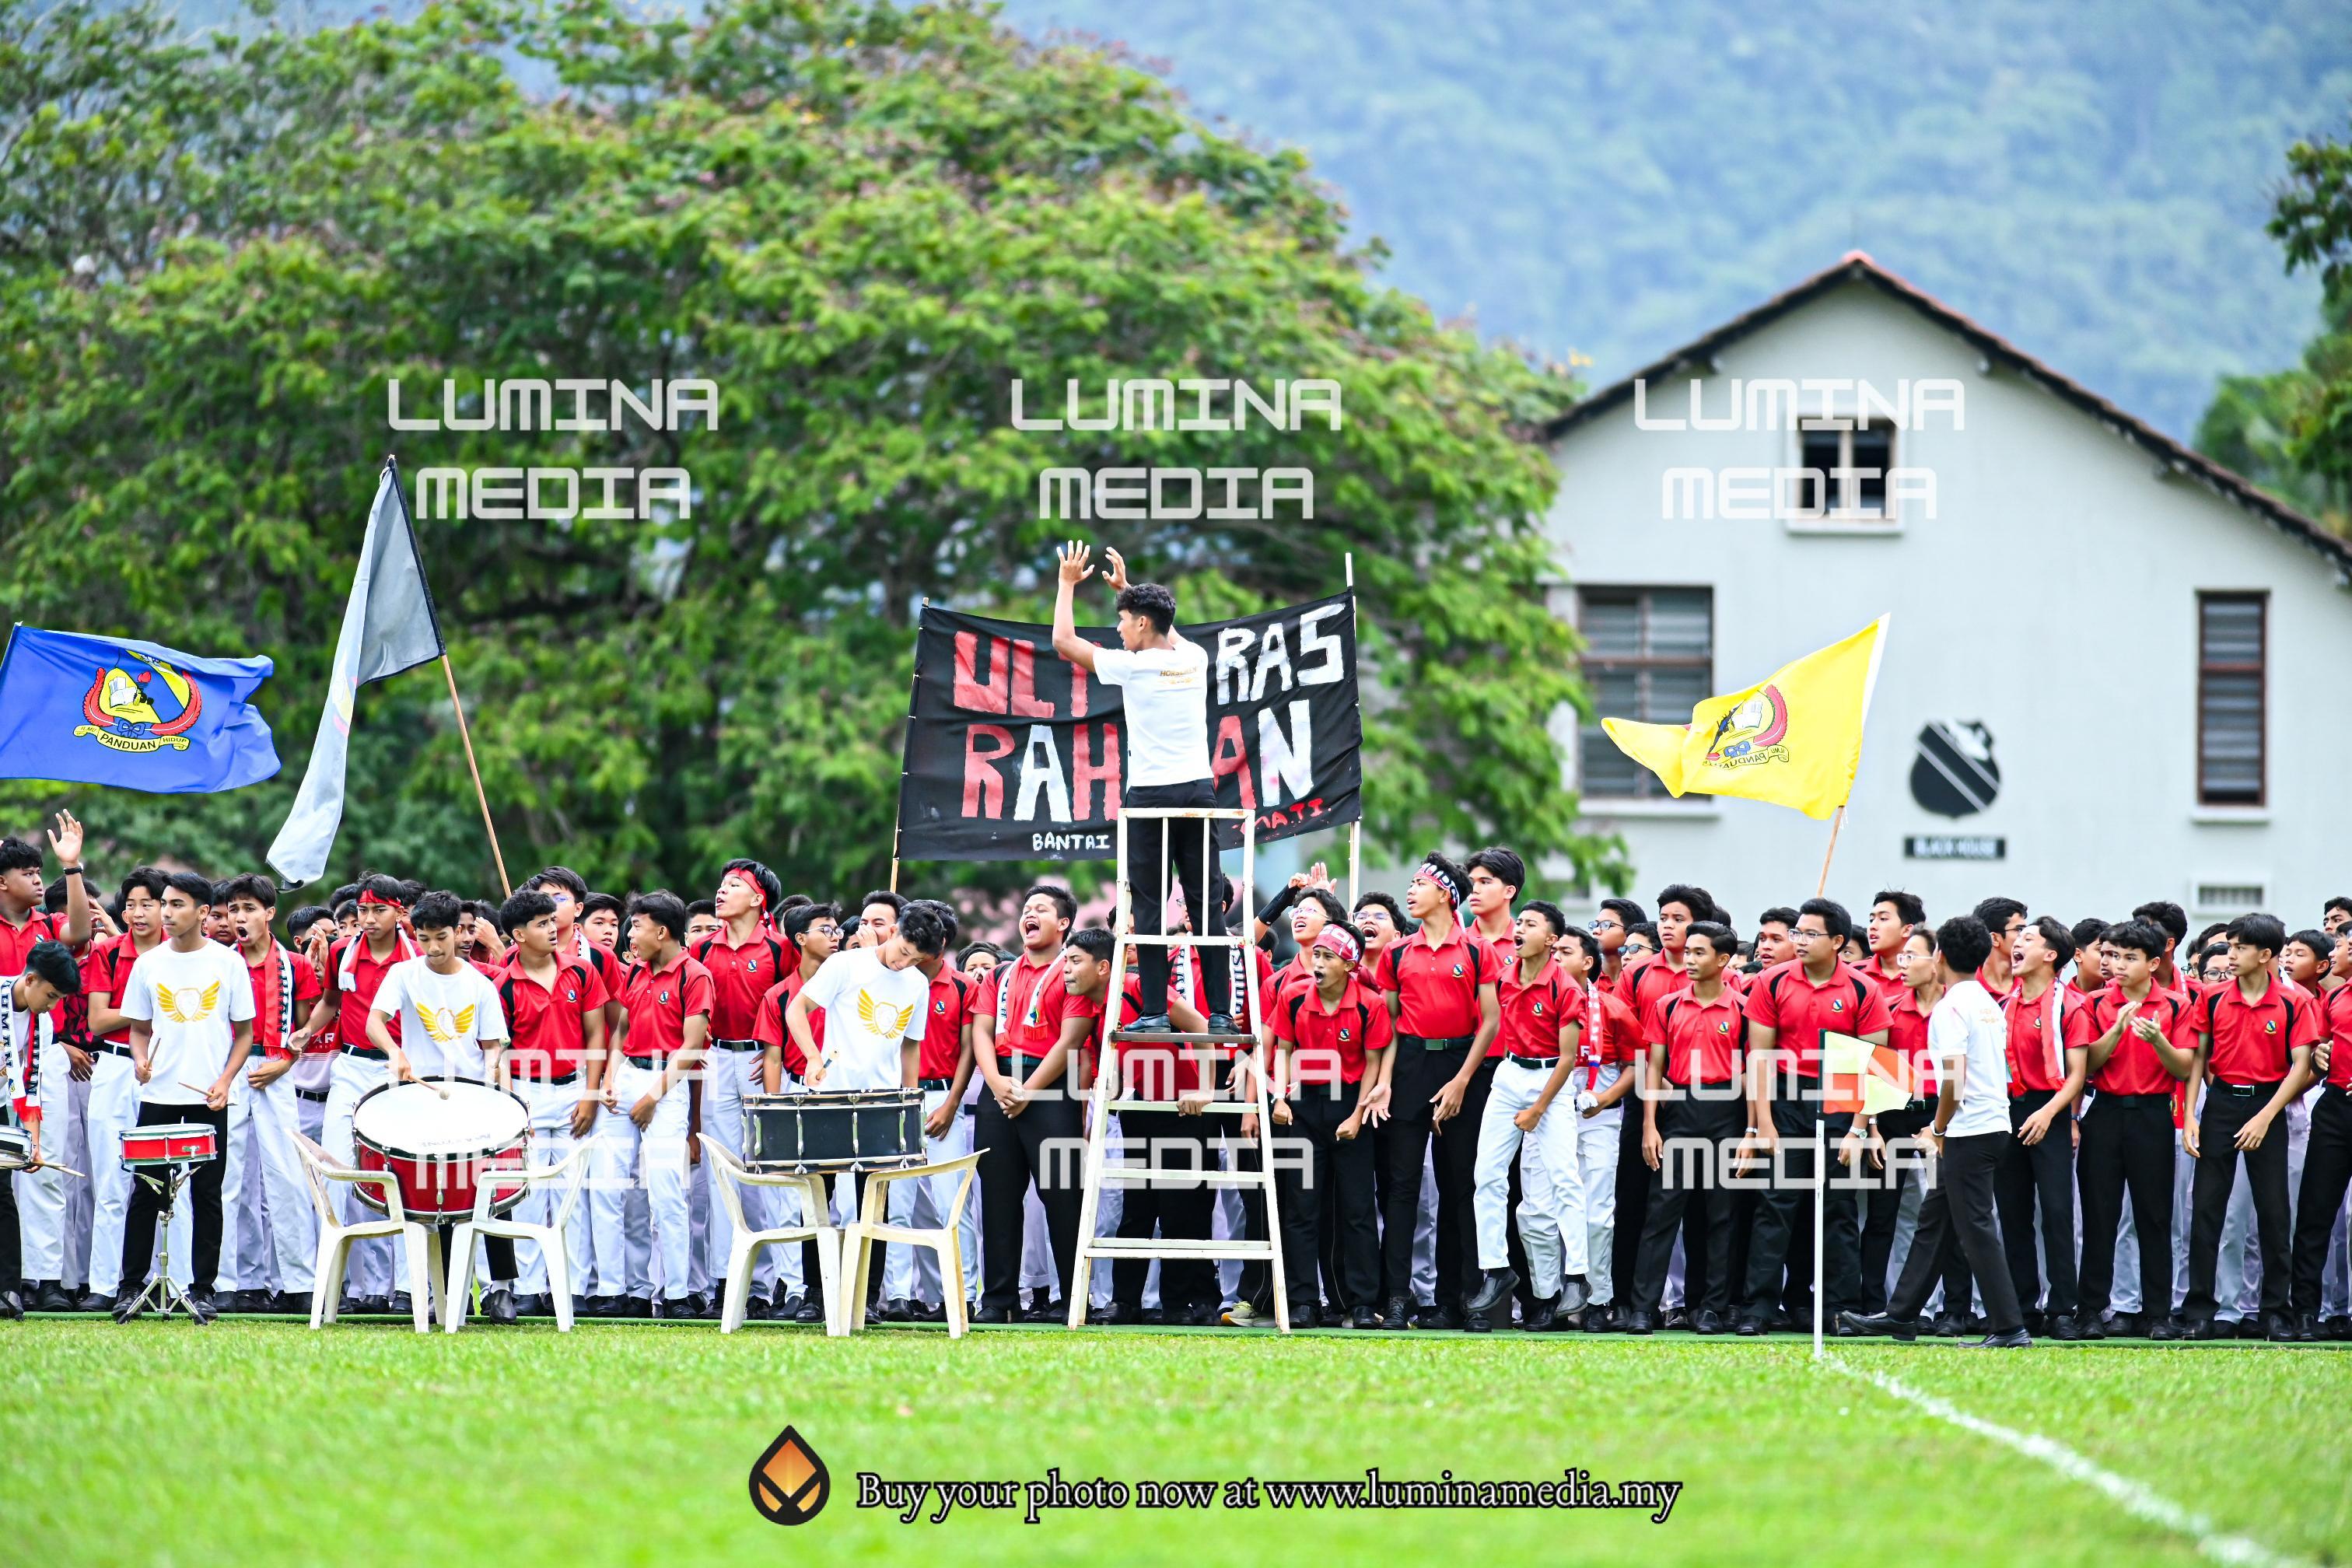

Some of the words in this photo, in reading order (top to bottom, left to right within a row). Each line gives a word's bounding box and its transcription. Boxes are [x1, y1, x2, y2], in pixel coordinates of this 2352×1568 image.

[100, 733, 156, 751] PANDUAN
[961, 699, 1313, 822] RAHAN
[1032, 831, 1111, 852] BANTAI
